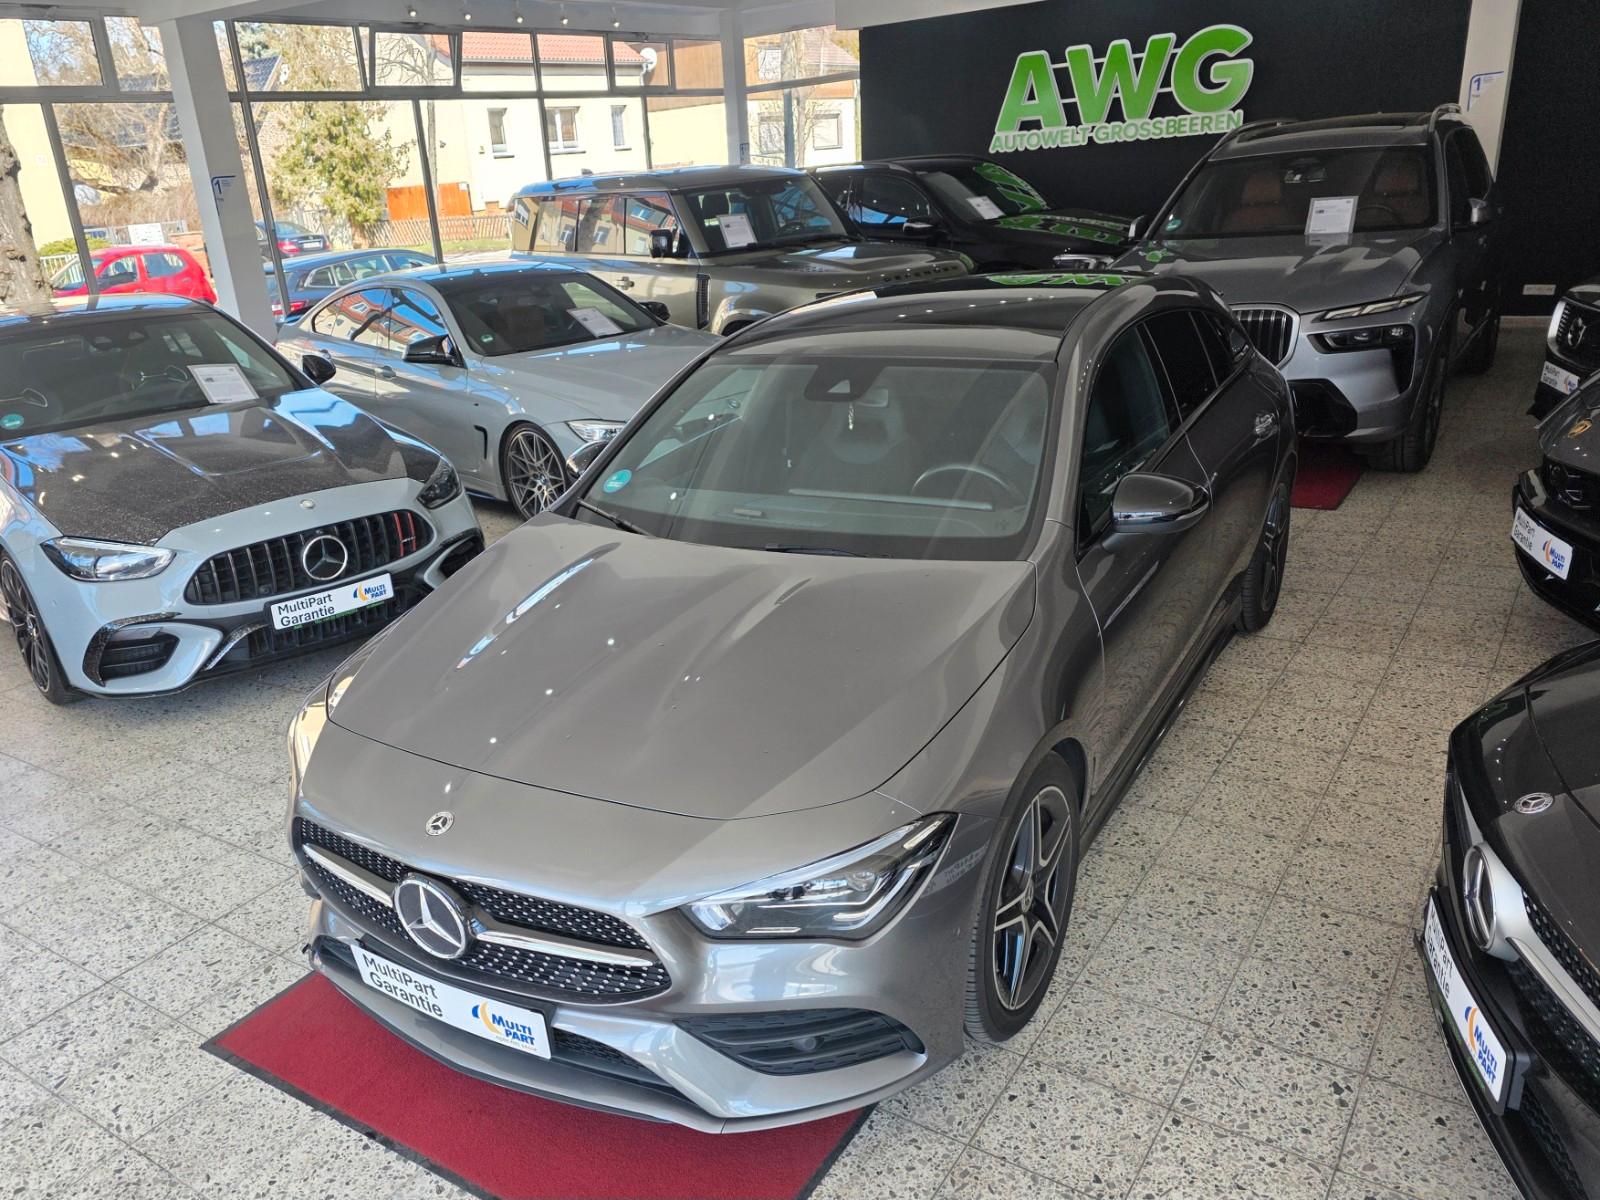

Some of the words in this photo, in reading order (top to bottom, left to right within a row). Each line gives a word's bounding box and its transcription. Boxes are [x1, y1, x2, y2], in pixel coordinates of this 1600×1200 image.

[995, 24, 1254, 131] AWG
[990, 126, 1088, 152] AUTOWELT
[1094, 111, 1244, 142] GROSSBEEREN
[1552, 559, 1565, 571] PART
[278, 594, 333, 615] MultiPart
[371, 589, 387, 599] PART
[280, 605, 335, 627] Garantie
[363, 954, 439, 999] MultiPart
[370, 972, 443, 1018] Garantie
[505, 1029, 536, 1046] PART
[1474, 1025, 1498, 1071] MULTI
[1478, 1051, 1497, 1085] PART
